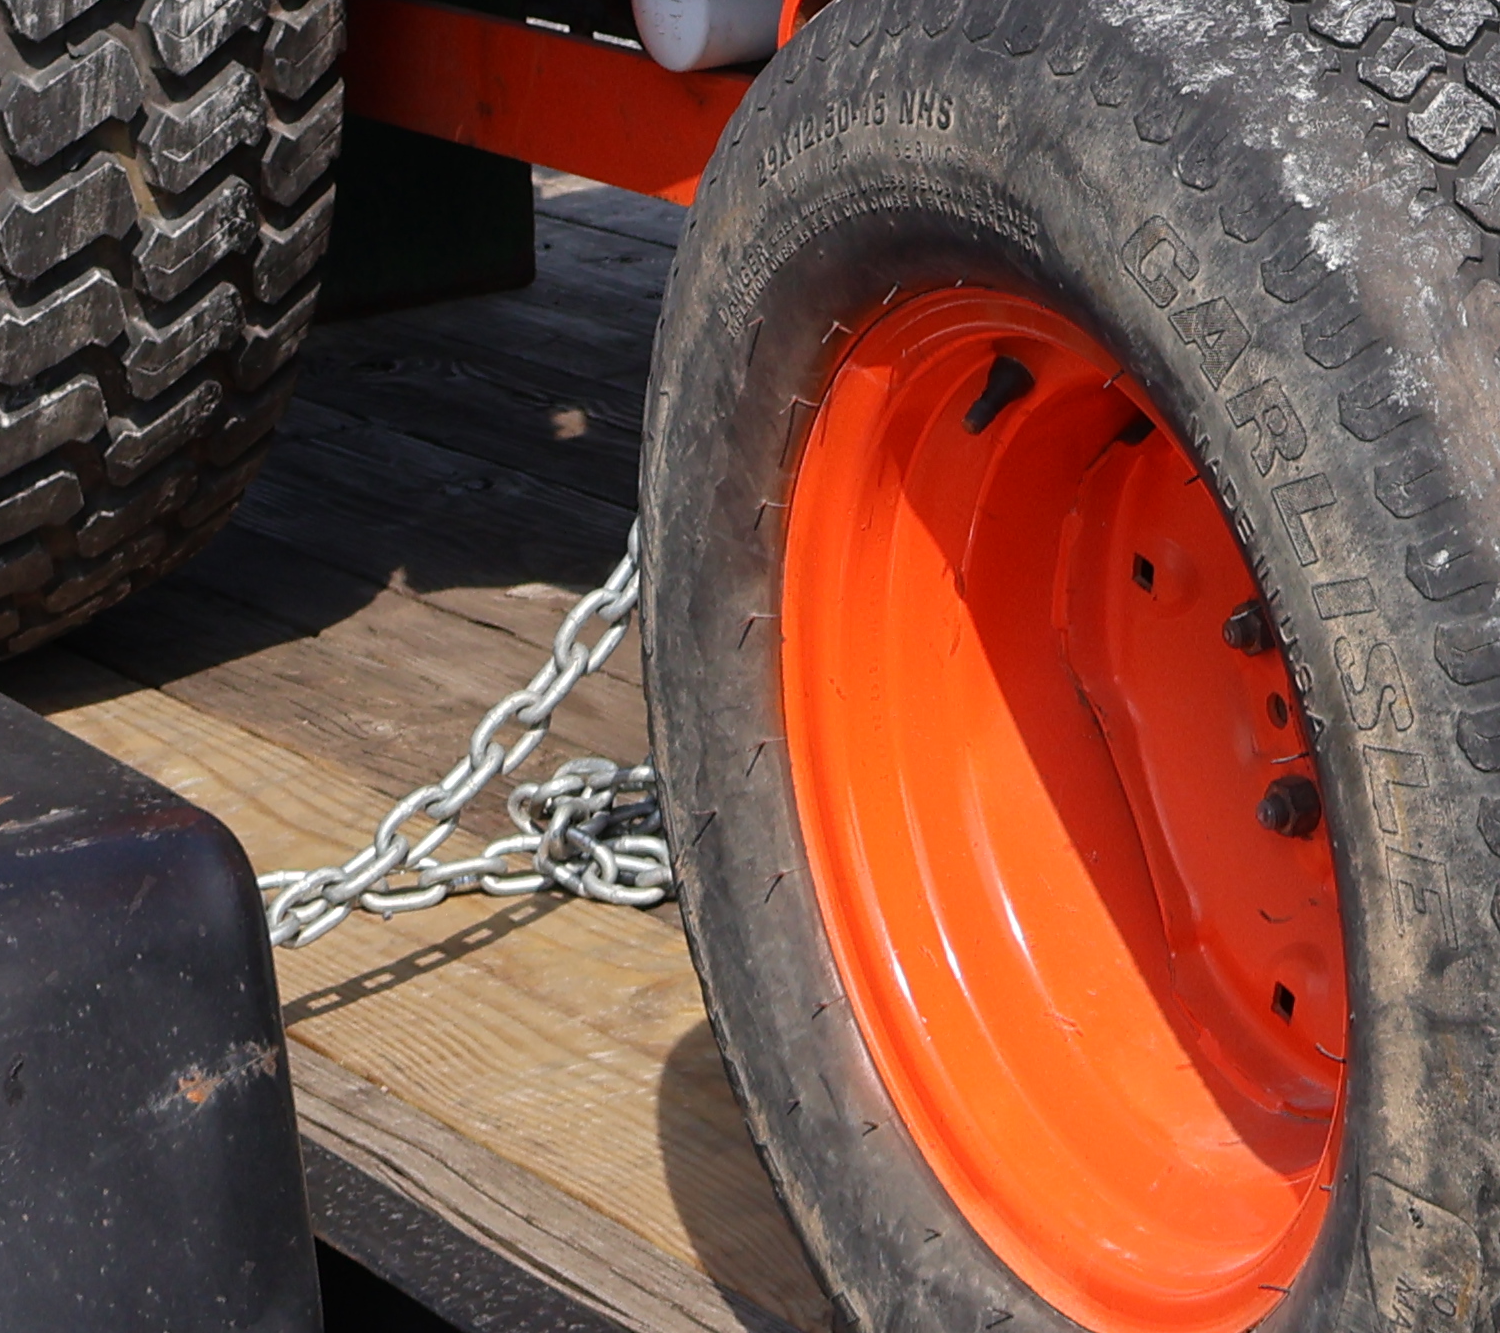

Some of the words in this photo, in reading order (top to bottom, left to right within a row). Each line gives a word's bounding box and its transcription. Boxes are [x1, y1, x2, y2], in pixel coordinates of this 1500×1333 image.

[899, 88, 956, 131] NHS
[1188, 411, 1257, 546] MADE
[1120, 214, 1460, 951] CARLISLE
